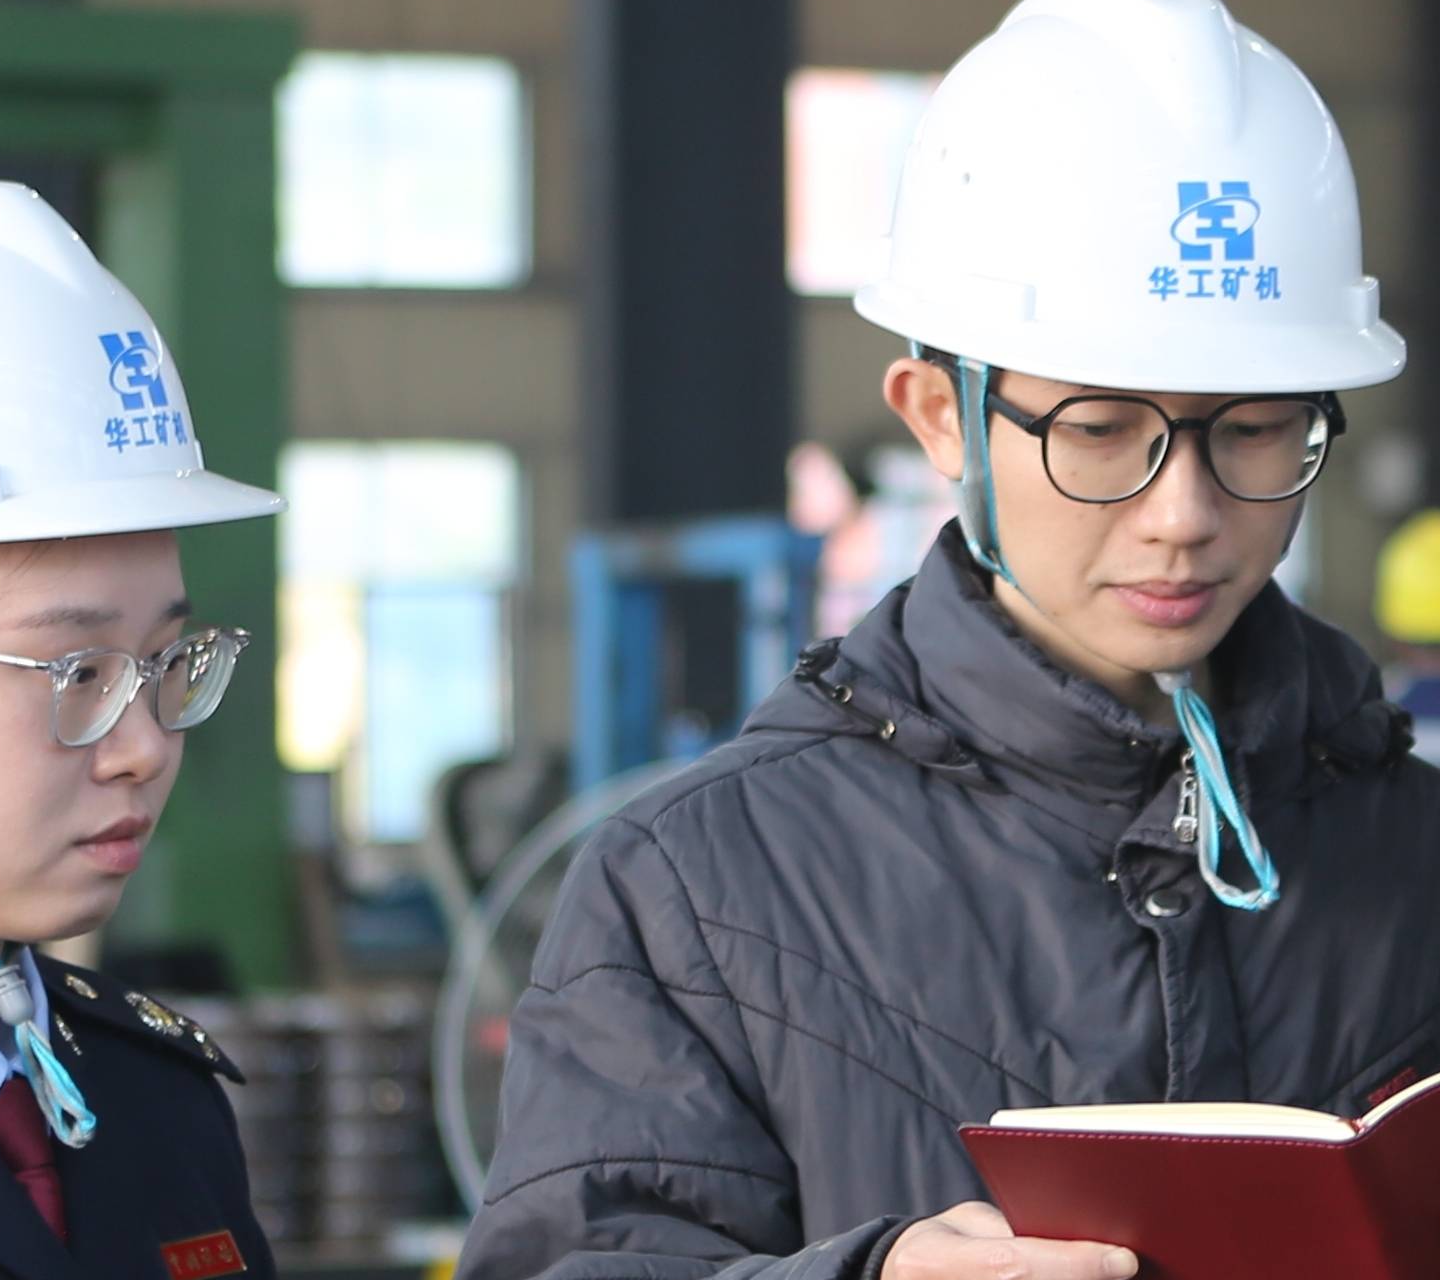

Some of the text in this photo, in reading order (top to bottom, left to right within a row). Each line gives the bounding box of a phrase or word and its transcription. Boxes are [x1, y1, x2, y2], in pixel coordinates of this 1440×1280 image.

[1148, 266, 1282, 302] 华工矿机
[104, 410, 188, 453] 华工矿机
